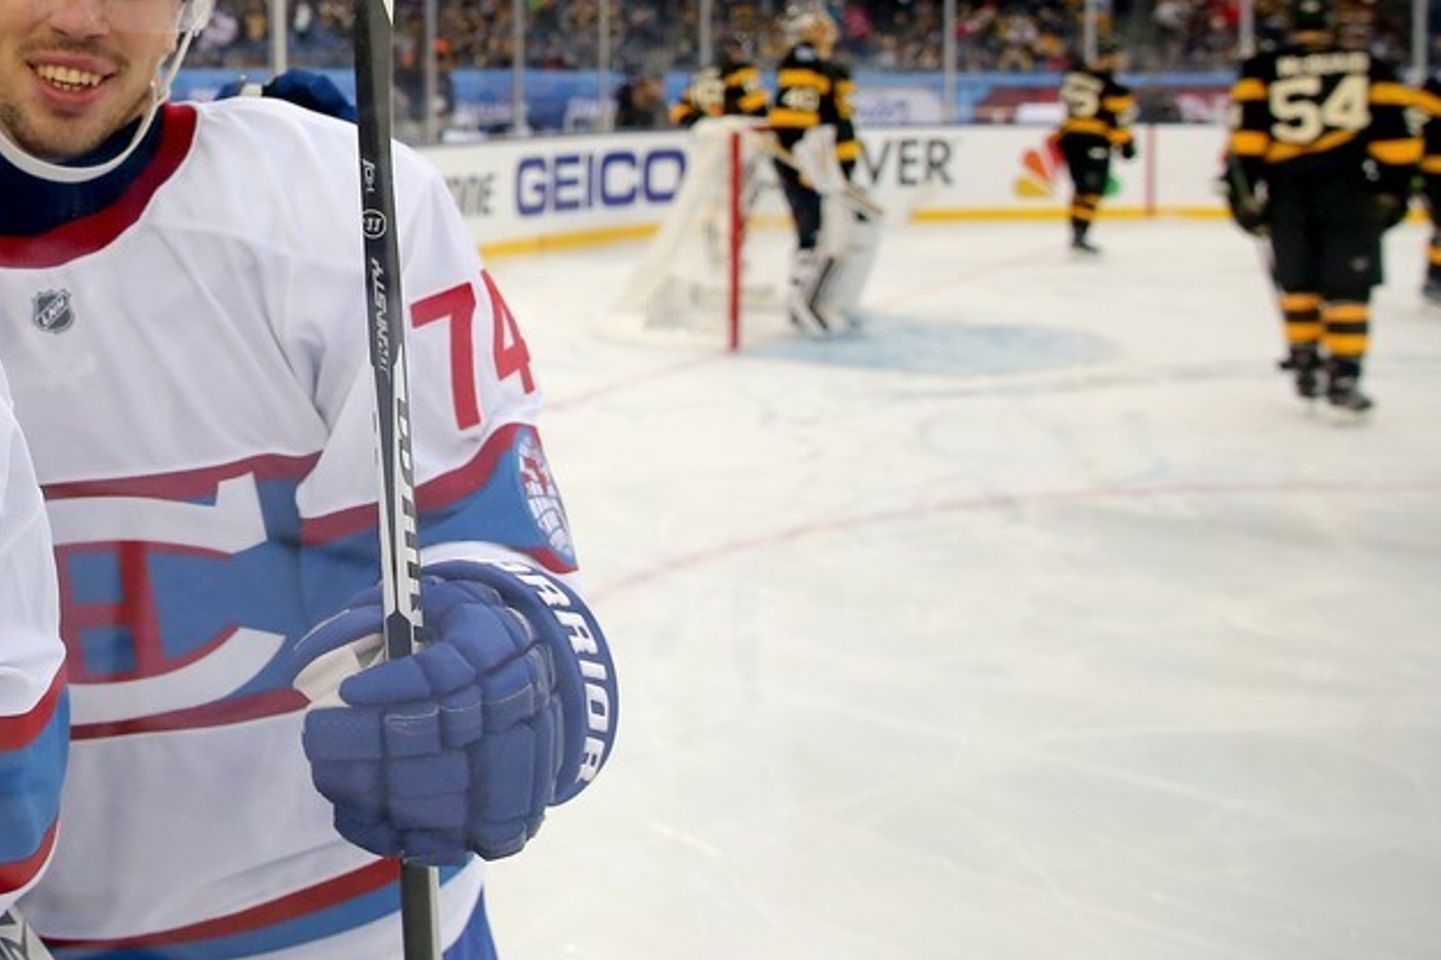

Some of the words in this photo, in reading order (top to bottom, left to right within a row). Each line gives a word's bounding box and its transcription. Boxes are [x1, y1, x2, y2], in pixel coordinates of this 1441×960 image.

[1268, 75, 1372, 144] 54
[516, 149, 688, 218] GEICO
[409, 269, 536, 432] 74
